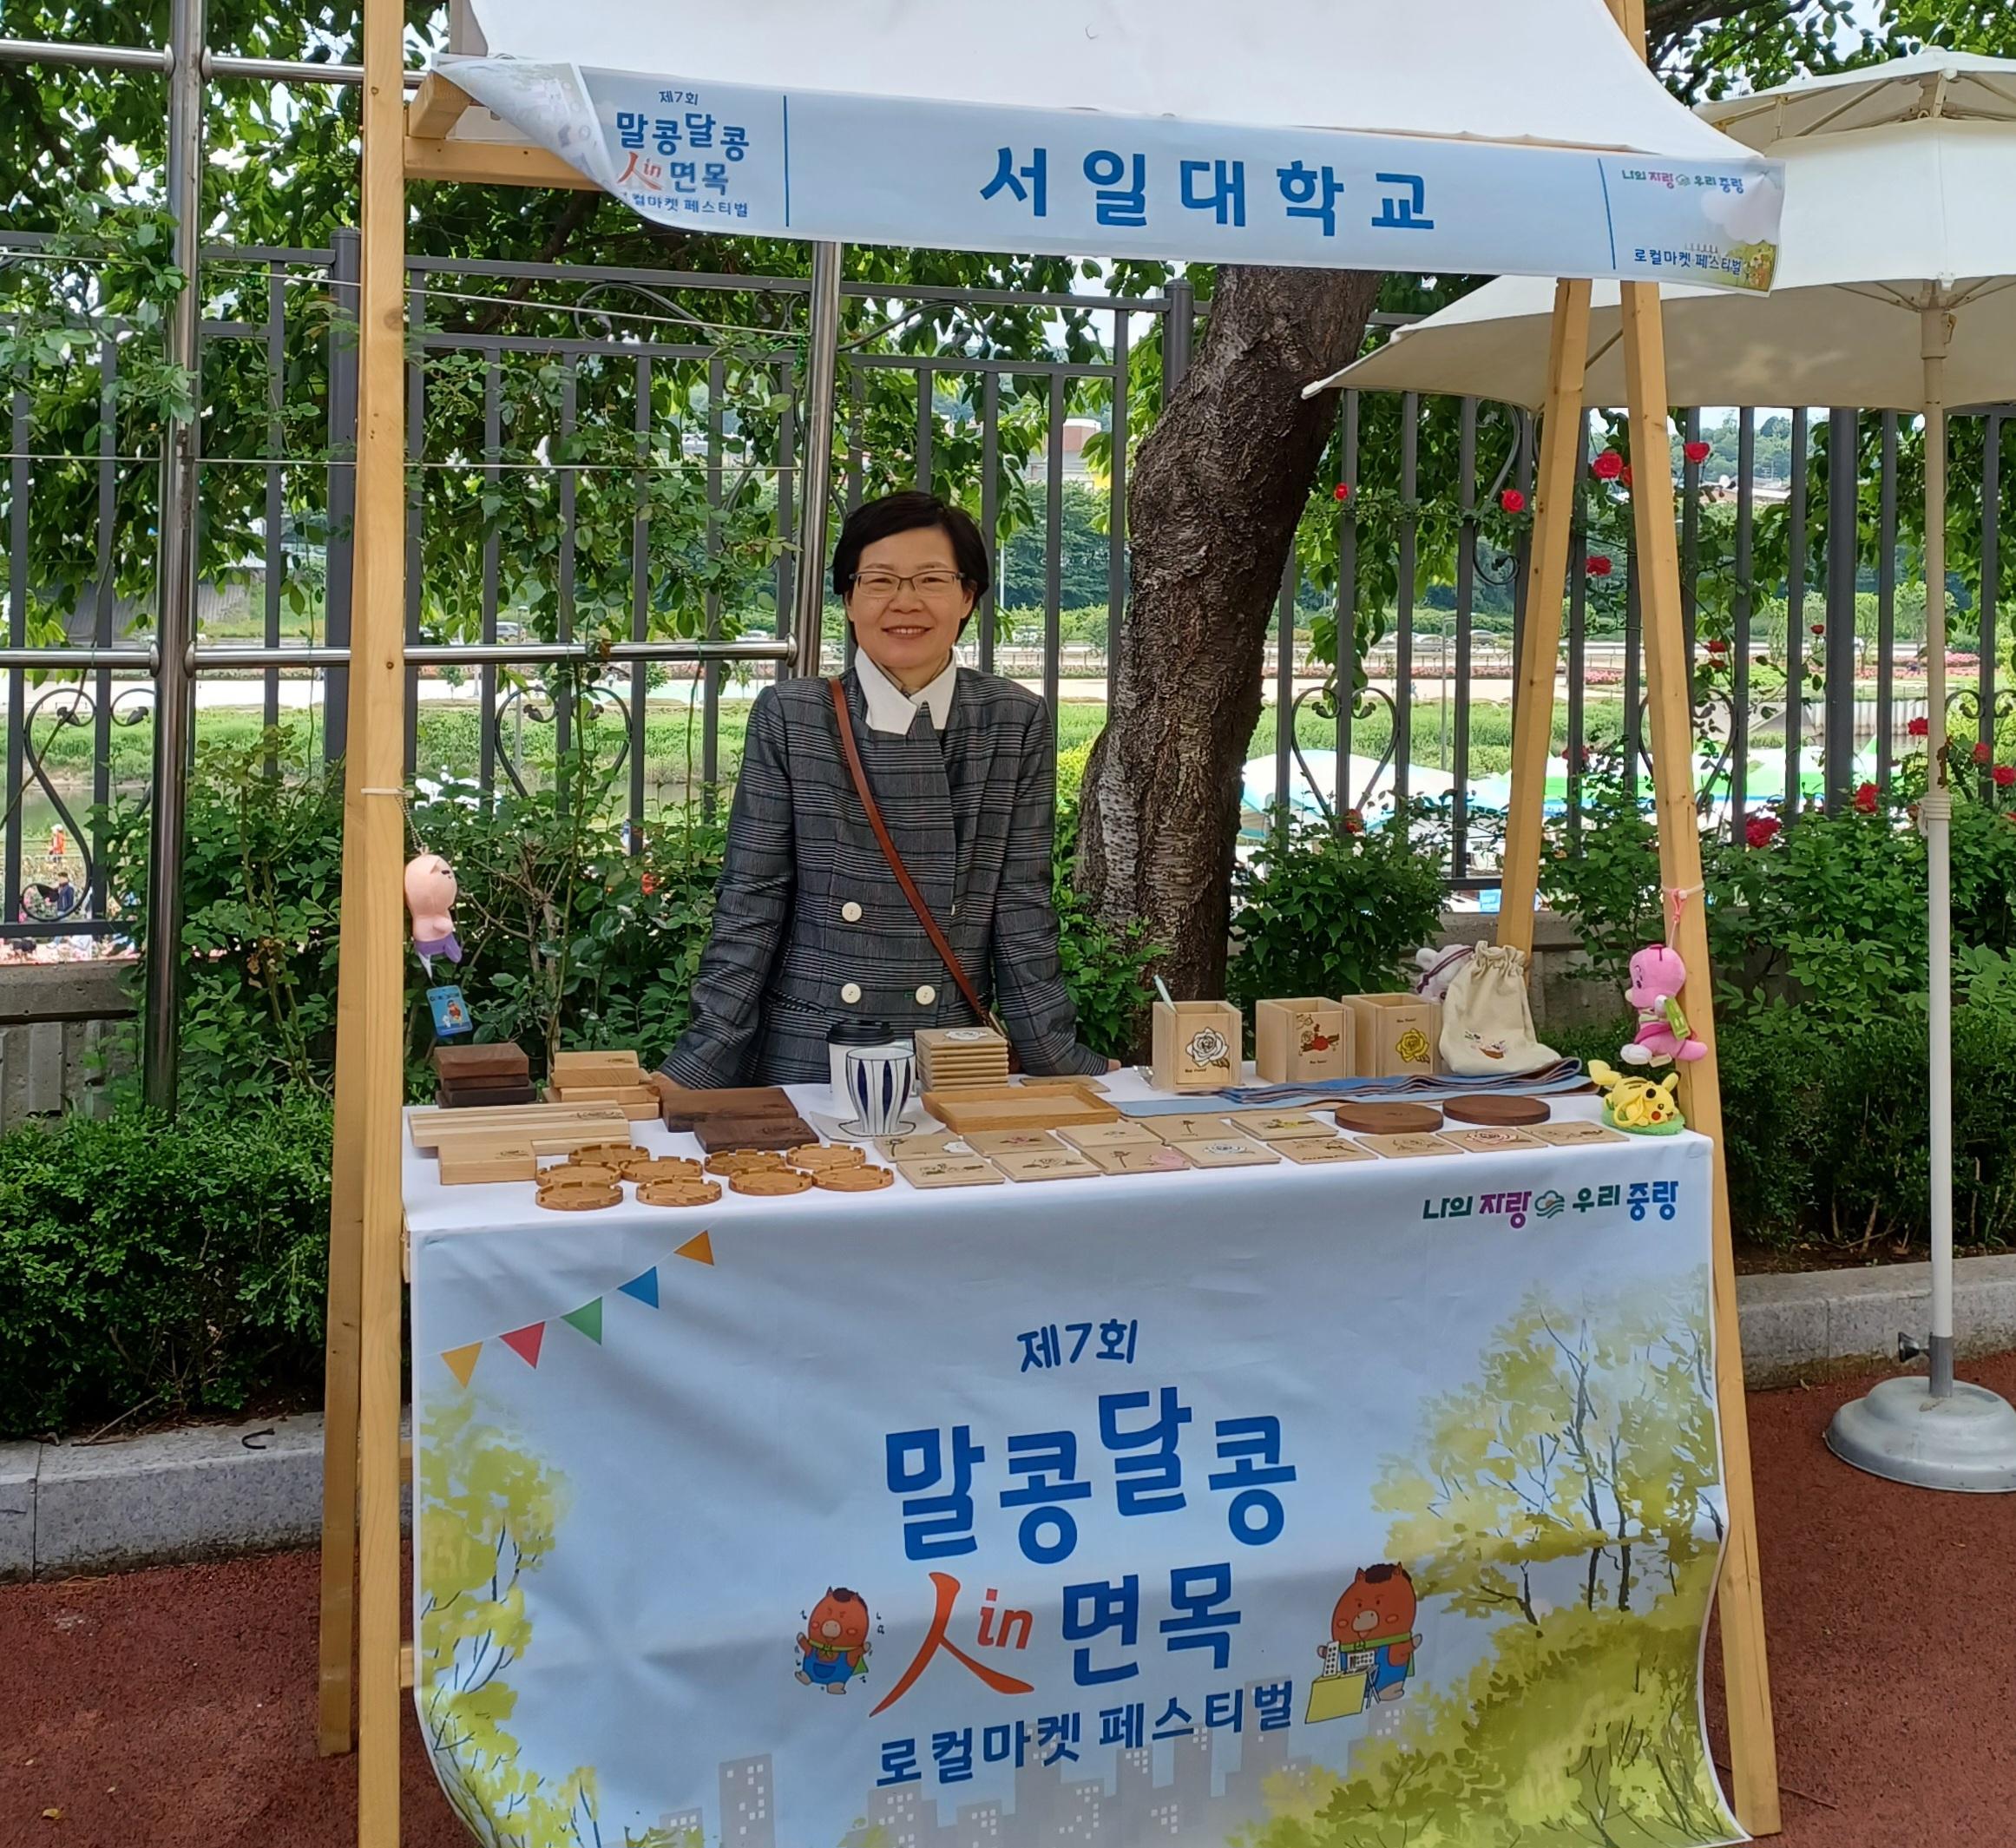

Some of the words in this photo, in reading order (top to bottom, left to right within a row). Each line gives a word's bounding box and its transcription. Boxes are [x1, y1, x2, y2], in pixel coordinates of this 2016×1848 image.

[659, 90, 699, 105] 제7회
[617, 112, 749, 161] 말콩달콩
[670, 161, 729, 196] 면목
[981, 147, 1435, 237] 서일대학교
[1694, 175, 1717, 187] 우리
[1719, 176, 1744, 194] 중랑
[622, 192, 679, 212] 컬마켓
[684, 200, 748, 218] 페스티벌
[1634, 249, 1691, 267] 로컬마켓
[1695, 253, 1742, 276] 페스티벌
[1422, 1195, 1474, 1220] 나의
[1479, 1191, 1533, 1229] 자랑
[1573, 1185, 1620, 1213] 우리
[1626, 1180, 1679, 1221] 중랑
[1017, 1319, 1138, 1372] 제7회
[885, 1387, 1296, 1564] 말콩달콩
[1061, 1562, 1242, 1687] 면목
[876, 1713, 1081, 1787] 로컬마켓
[1099, 1680, 1294, 1749] 페스티벌
